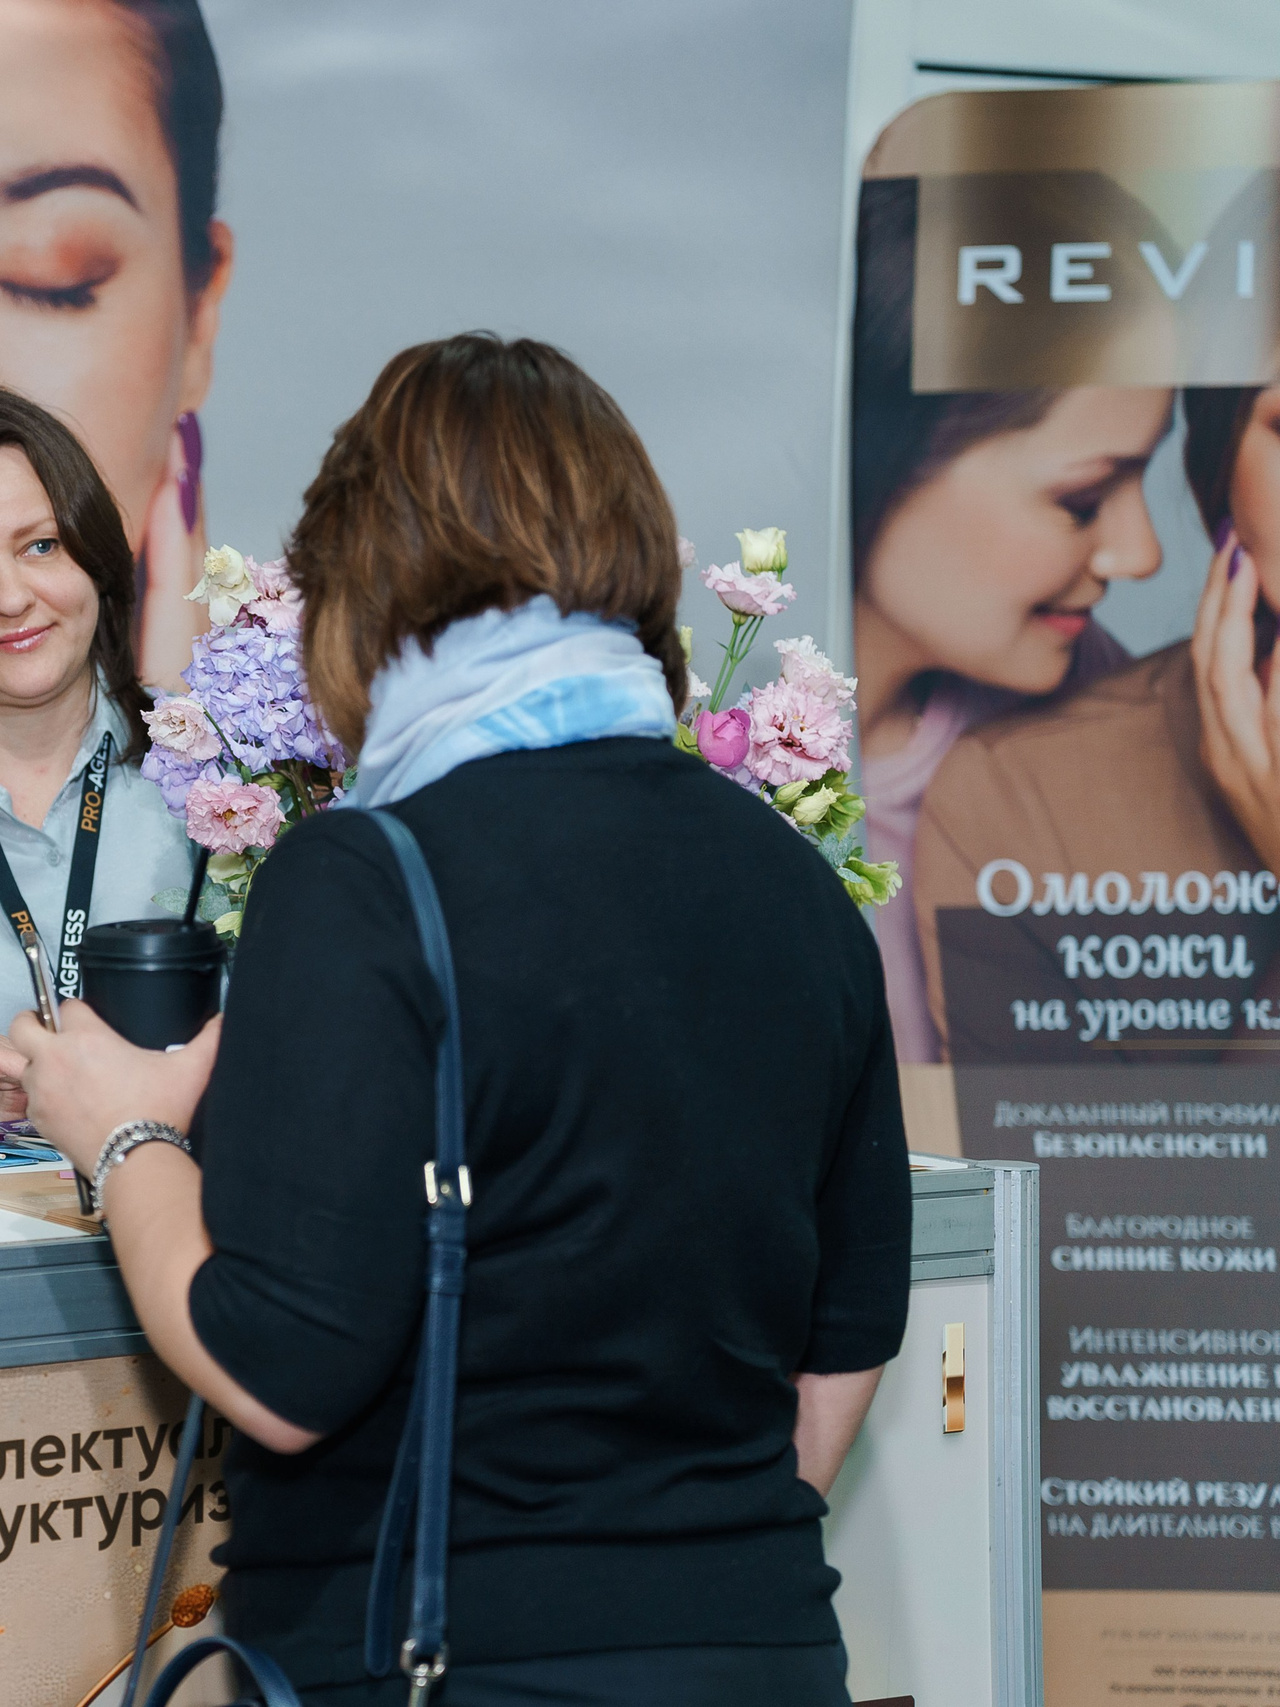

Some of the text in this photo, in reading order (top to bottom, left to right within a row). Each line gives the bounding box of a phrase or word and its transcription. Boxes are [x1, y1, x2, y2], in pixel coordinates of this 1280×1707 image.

[957, 239, 1255, 305] REVI
[976, 858, 1280, 917] Омолож
[1056, 934, 1255, 979] кожи
[1010, 998, 1071, 1032] на
[1075, 998, 1232, 1042] уровне
